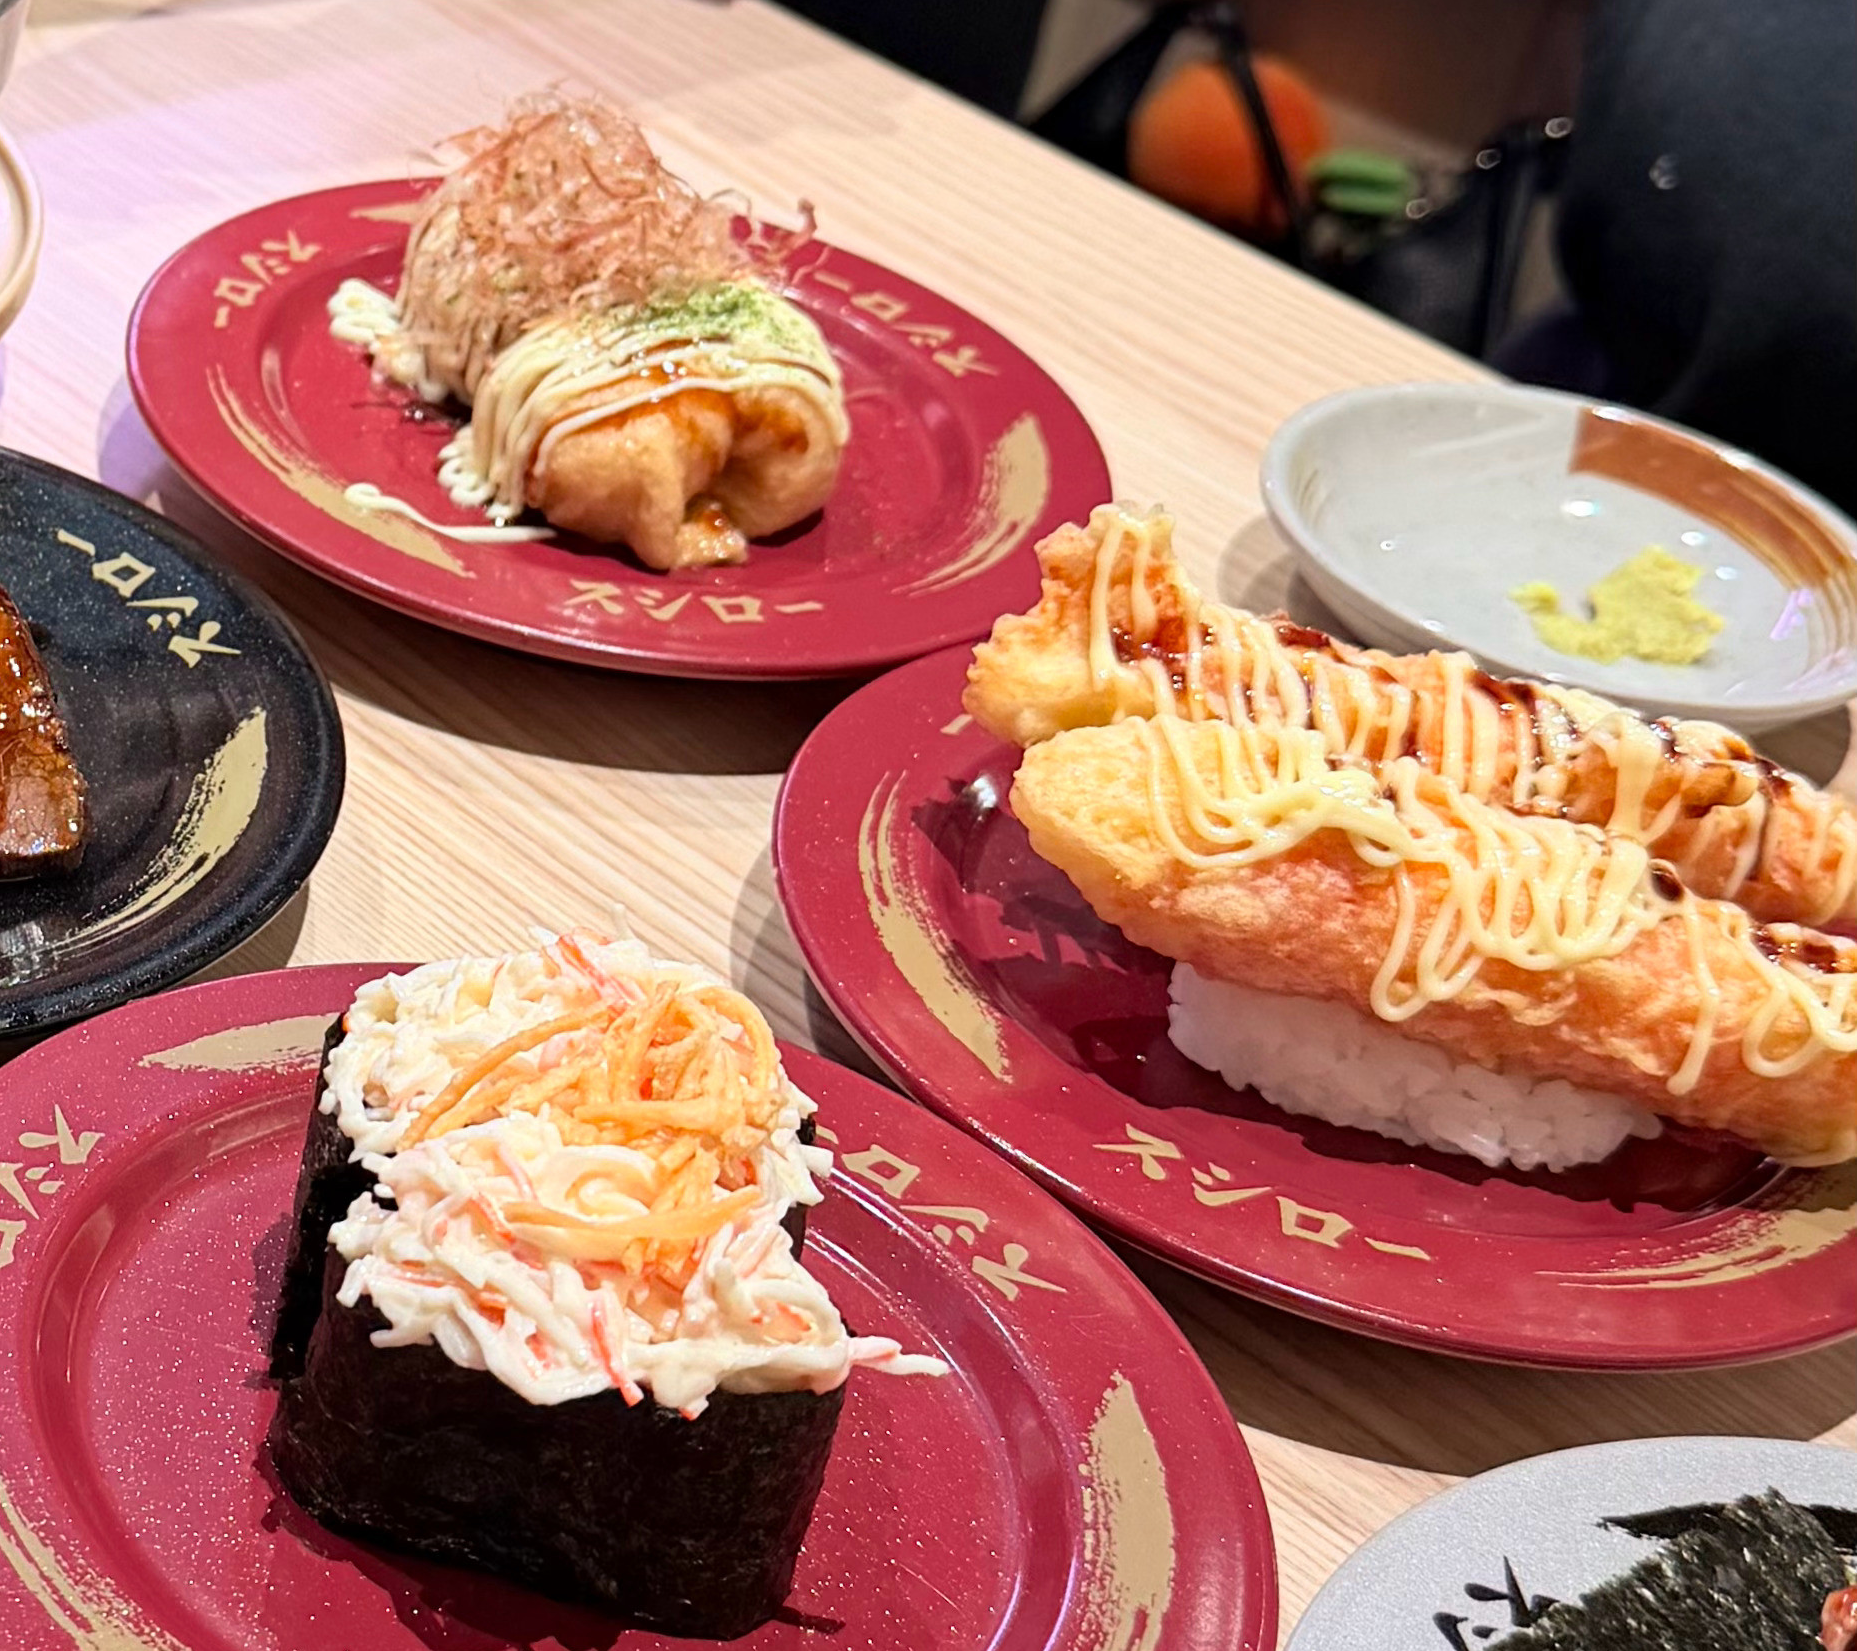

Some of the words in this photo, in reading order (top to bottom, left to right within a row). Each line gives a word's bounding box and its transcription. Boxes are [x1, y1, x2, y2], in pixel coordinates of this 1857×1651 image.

[55, 529, 242, 670] スシロー
[563, 578, 824, 624] スシロー
[1093, 1123, 1434, 1262] スシロー
